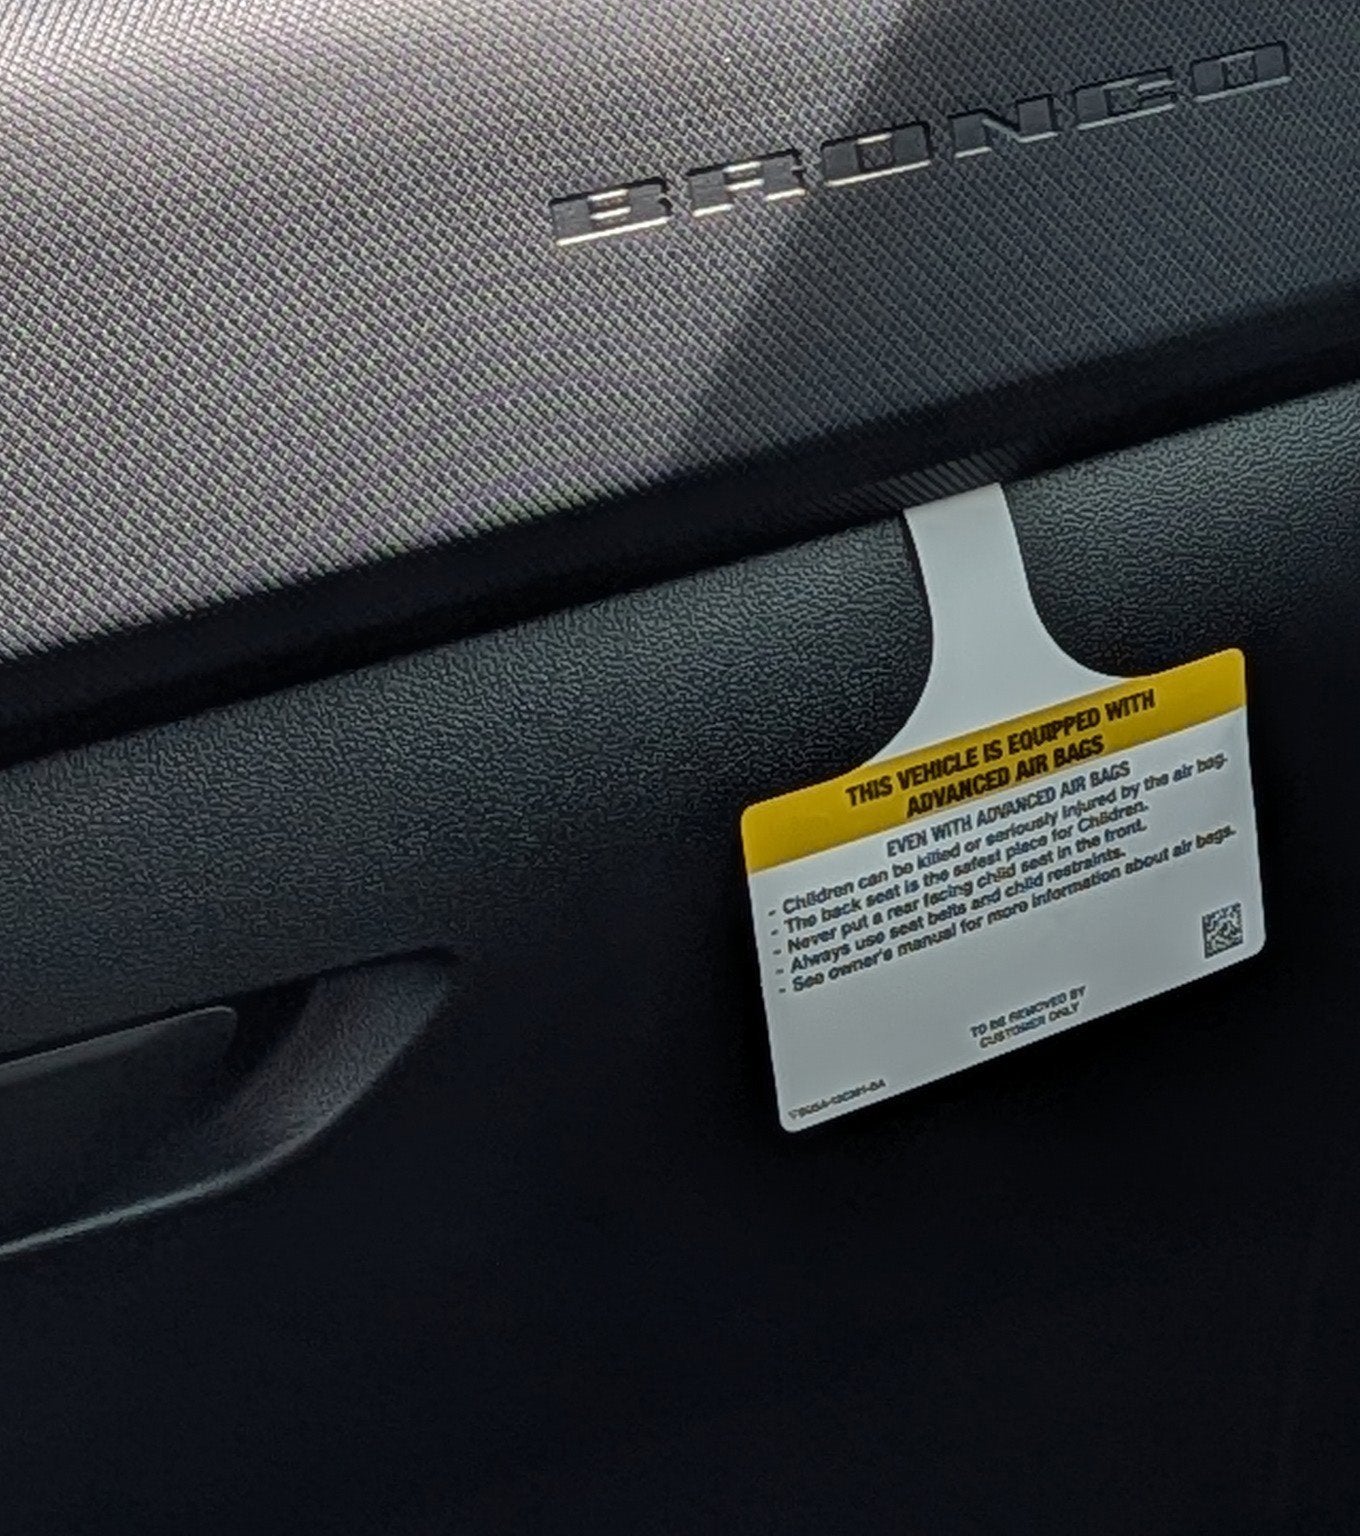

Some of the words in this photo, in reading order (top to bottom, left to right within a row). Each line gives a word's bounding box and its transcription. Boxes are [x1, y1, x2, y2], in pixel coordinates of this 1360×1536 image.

[549, 41, 1292, 248] BRONCO
[845, 775, 893, 807] THIS
[896, 746, 980, 791] VEHICLE
[982, 739, 1003, 763] IS
[1007, 707, 1101, 755] EQUIPPED
[1104, 688, 1156, 722] WITH
[886, 829, 928, 857] EVEN
[930, 814, 973, 842] WITH
[976, 786, 1056, 827] ADVANCED
[1059, 775, 1086, 799] AIR
[1089, 760, 1131, 788] BAGS
[906, 766, 1011, 818] ADVANCED
[1015, 753, 1049, 782] AIR
[1053, 734, 1105, 768] BAGS
[782, 881, 854, 915] Children
[857, 870, 889, 890] can
[891, 862, 913, 878] be
[917, 841, 961, 870] killed
[963, 837, 981, 853] or
[984, 810, 1058, 847] seriously
[1061, 787, 1117, 820] injured
[1120, 782, 1141, 800] by
[1142, 773, 1169, 791] the
[1172, 763, 1193, 782] air
[1196, 752, 1228, 774] bag.
[783, 914, 818, 934] The
[820, 897, 861, 923] back
[865, 883, 901, 908] seat
[904, 879, 919, 895] is
[922, 868, 950, 887] the
[952, 848, 1001, 878] safest
[1005, 834, 1048, 862] place
[1050, 824, 1073, 843] for
[1076, 800, 1149, 833] Children.
[787, 926, 836, 955] Never
[840, 914, 868, 939] put
[872, 911, 882, 925] a
[886, 899, 920, 921] rear
[922, 880, 974, 908] facing
[976, 862, 1016, 889] child
[1020, 850, 1053, 874] seat
[1057, 845, 1072, 860] in
[1074, 835, 1101, 853] the
[1103, 818, 1147, 843] front.
[790, 943, 851, 974] Always
[855, 931, 884, 951] use
[889, 915, 925, 939] seat
[927, 902, 967, 926] belts
[970, 886, 1001, 911] and
[1004, 871, 1044, 898] child
[1046, 847, 1126, 883] restraints.
[791, 971, 825, 992] See
[827, 947, 893, 980] owner's
[897, 922, 957, 956] manual
[959, 915, 982, 934] for
[987, 900, 1029, 925] more
[1031, 866, 1121, 908] information
[1124, 847, 1170, 875] about
[1172, 839, 1192, 858] air
[1195, 825, 1236, 849] bags.
[969, 1023, 988, 1038] TO
[1008, 992, 1067, 1023] REMOVED
[1069, 985, 1086, 1000] BY
[979, 1014, 1046, 1048] CUSTOMER
[1048, 1001, 1080, 1022] ONLY
